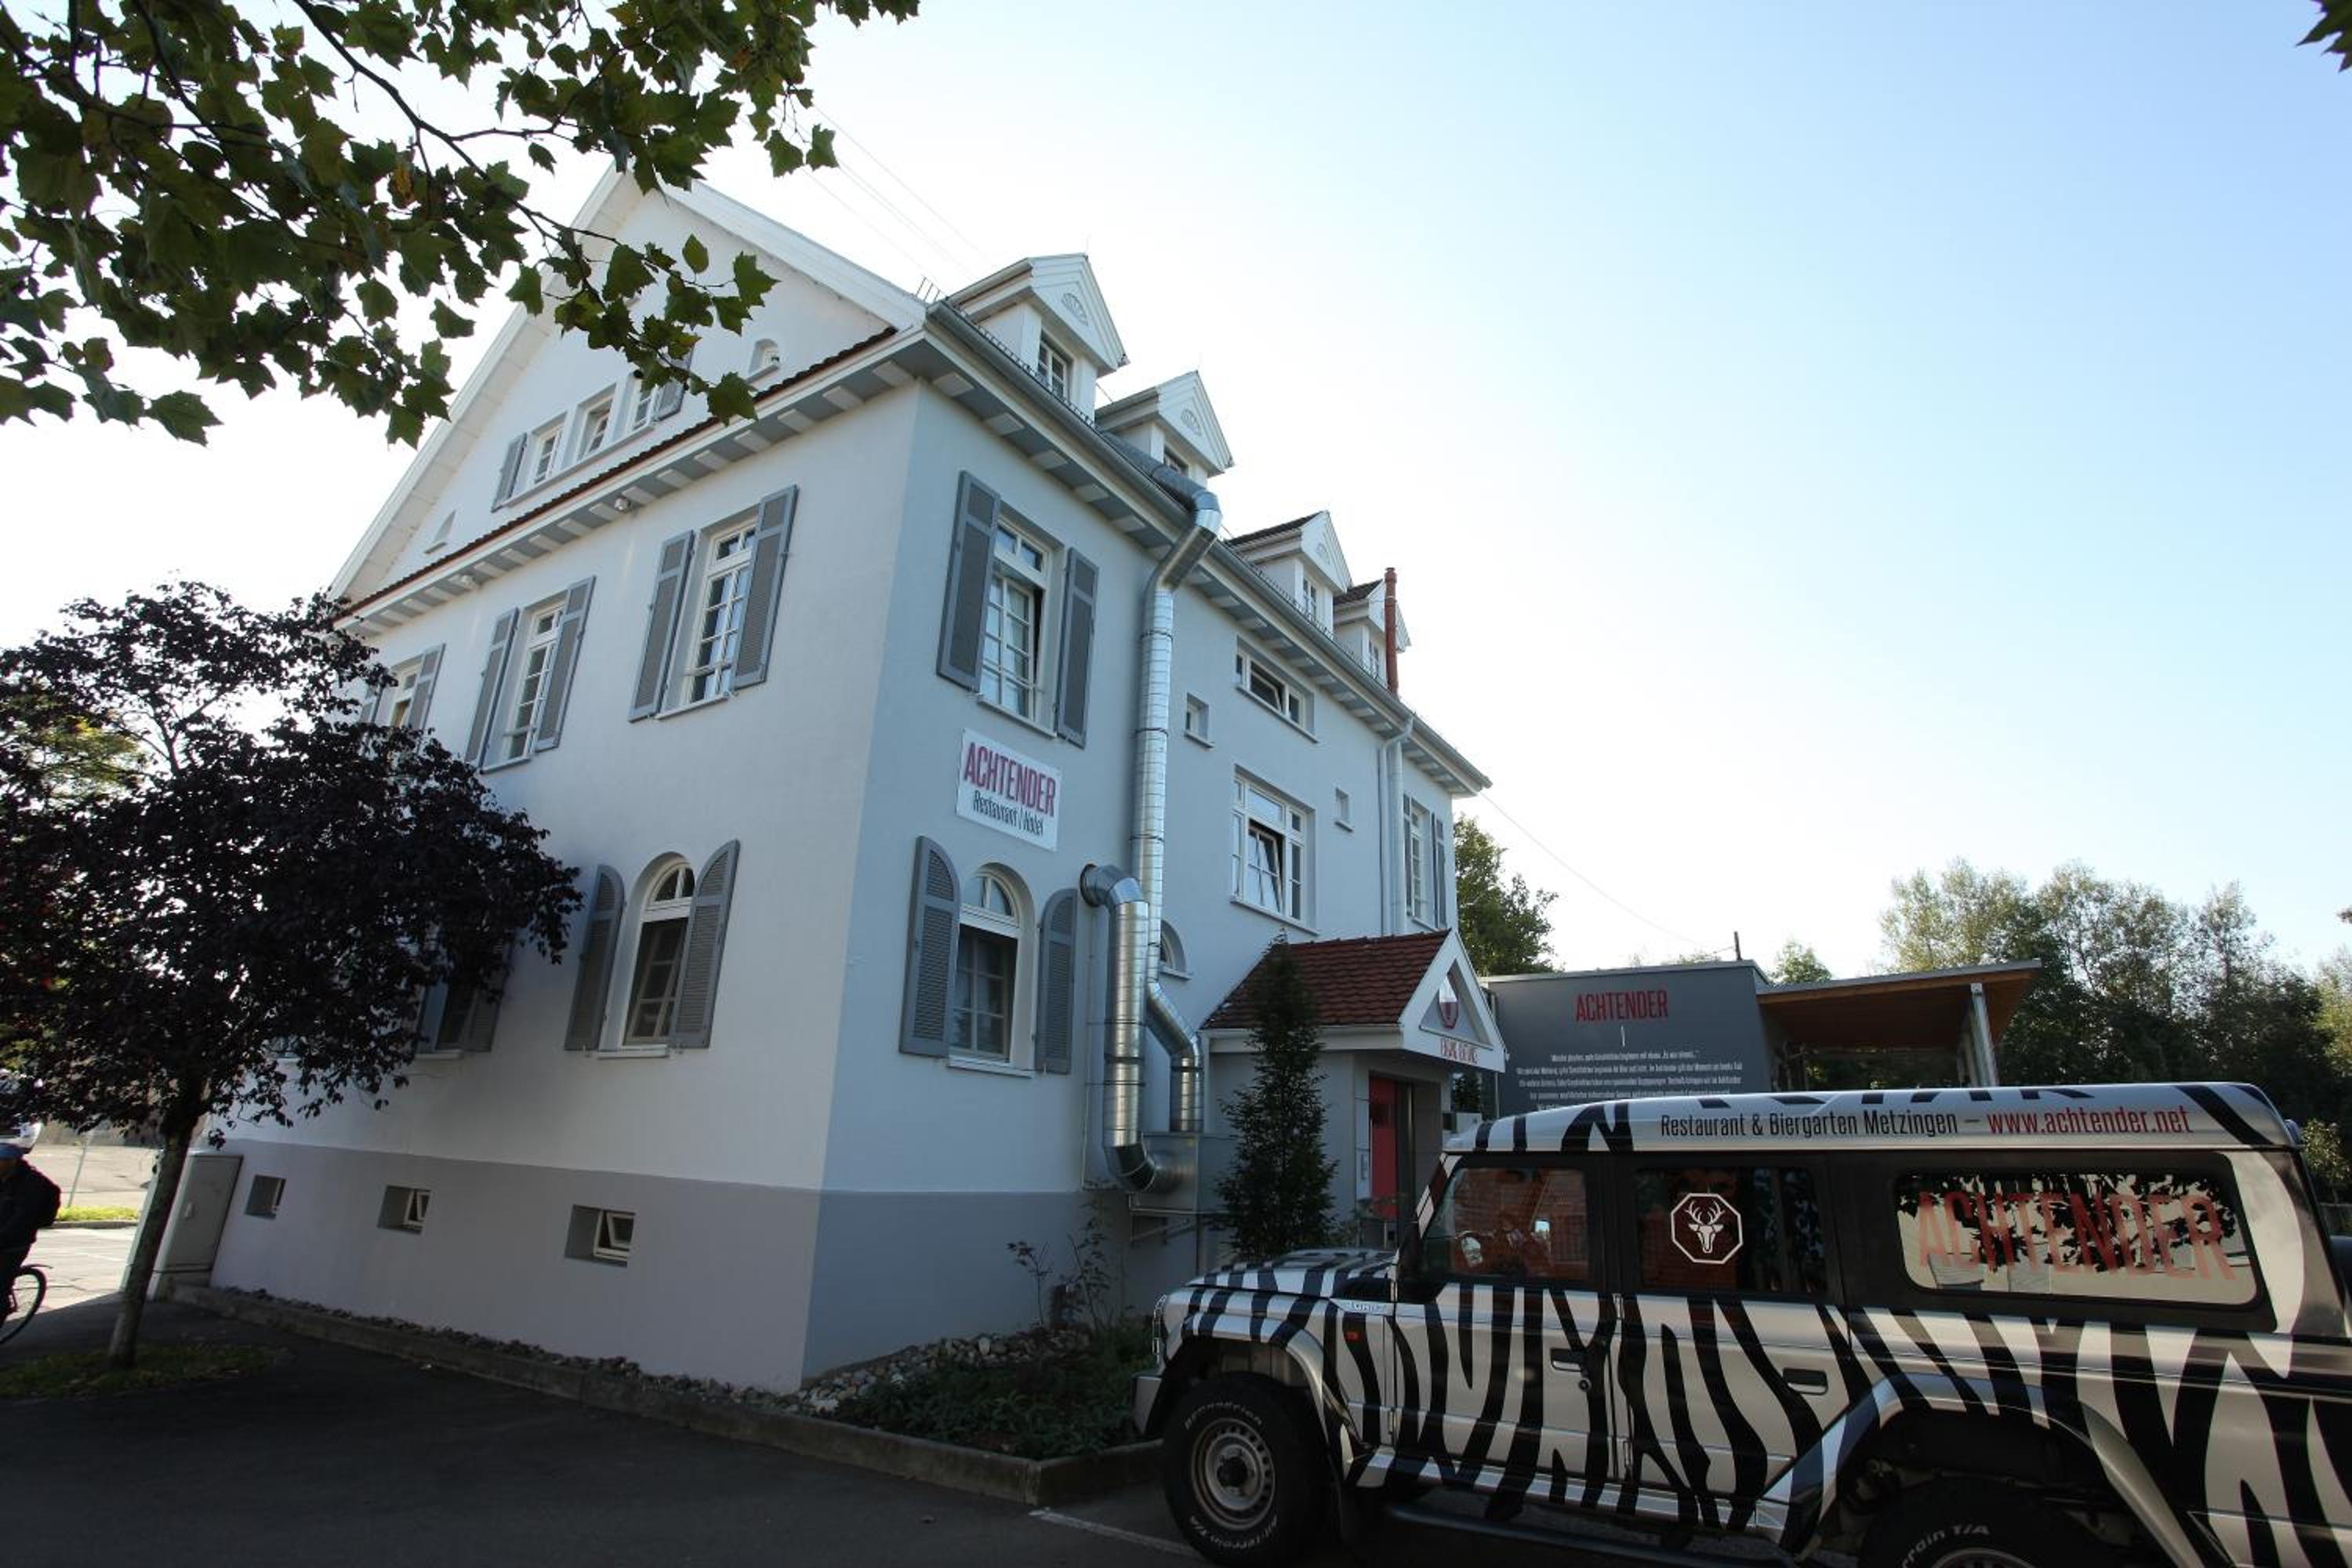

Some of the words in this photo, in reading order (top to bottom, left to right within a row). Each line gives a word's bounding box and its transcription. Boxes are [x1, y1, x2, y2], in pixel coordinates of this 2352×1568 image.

[964, 742, 1056, 817] ACHTENDER
[973, 789, 1018, 827] Restaurant
[1575, 989, 1669, 1022] ACHTENDER
[1661, 1115, 1747, 1137] Restaurant
[1752, 1115, 1764, 1136] &
[1769, 1112, 1858, 1138] Biergarten
[1864, 1109, 1958, 1138] Metzingen
[1987, 1105, 2194, 1134] www.achtender.net
[1918, 1191, 2240, 1280] ACHTENDER
